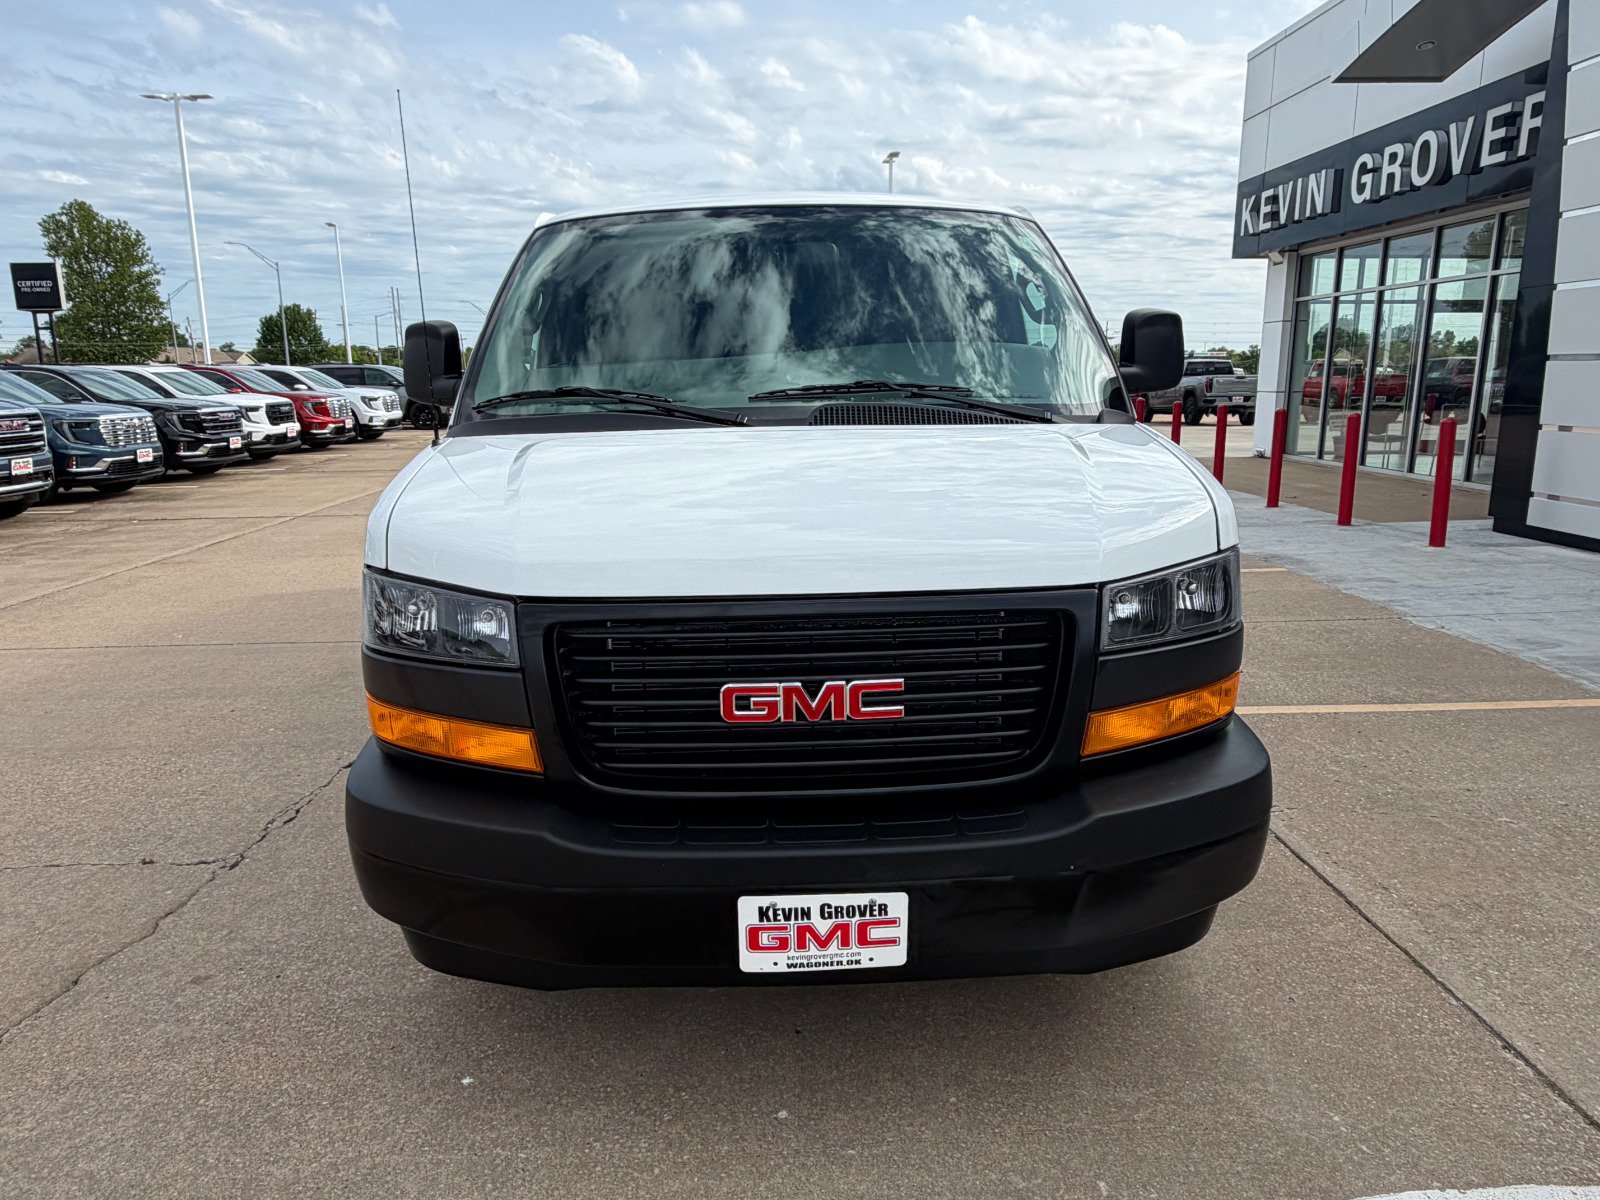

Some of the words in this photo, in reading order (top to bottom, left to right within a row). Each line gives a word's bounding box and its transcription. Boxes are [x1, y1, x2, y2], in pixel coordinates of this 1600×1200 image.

[1240, 168, 1327, 237] KEVIN
[720, 678, 905, 723] GMC
[758, 905, 812, 923] KEVIN
[819, 902, 889, 921] GROVER
[745, 917, 901, 954] GMC
[787, 951, 862, 961] kevingrovergmc.com
